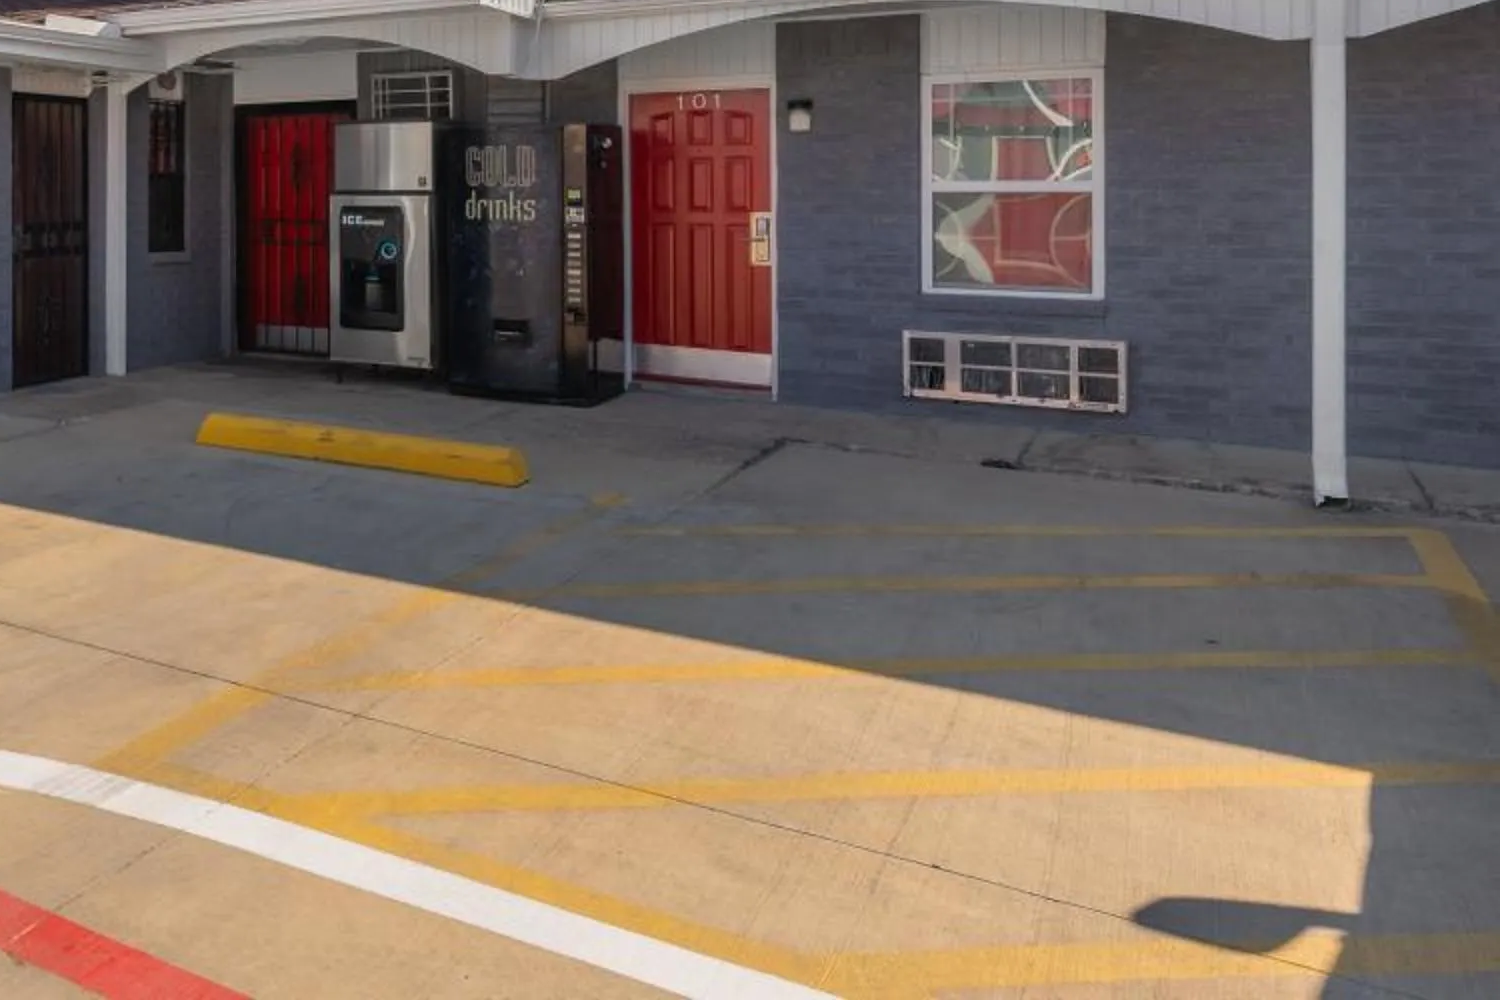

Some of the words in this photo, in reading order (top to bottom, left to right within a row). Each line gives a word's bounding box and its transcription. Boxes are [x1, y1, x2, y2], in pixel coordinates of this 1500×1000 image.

[676, 93, 720, 111] 101
[465, 144, 536, 188] COLD
[465, 189, 536, 221] drinks
[342, 215, 363, 225] ICE
